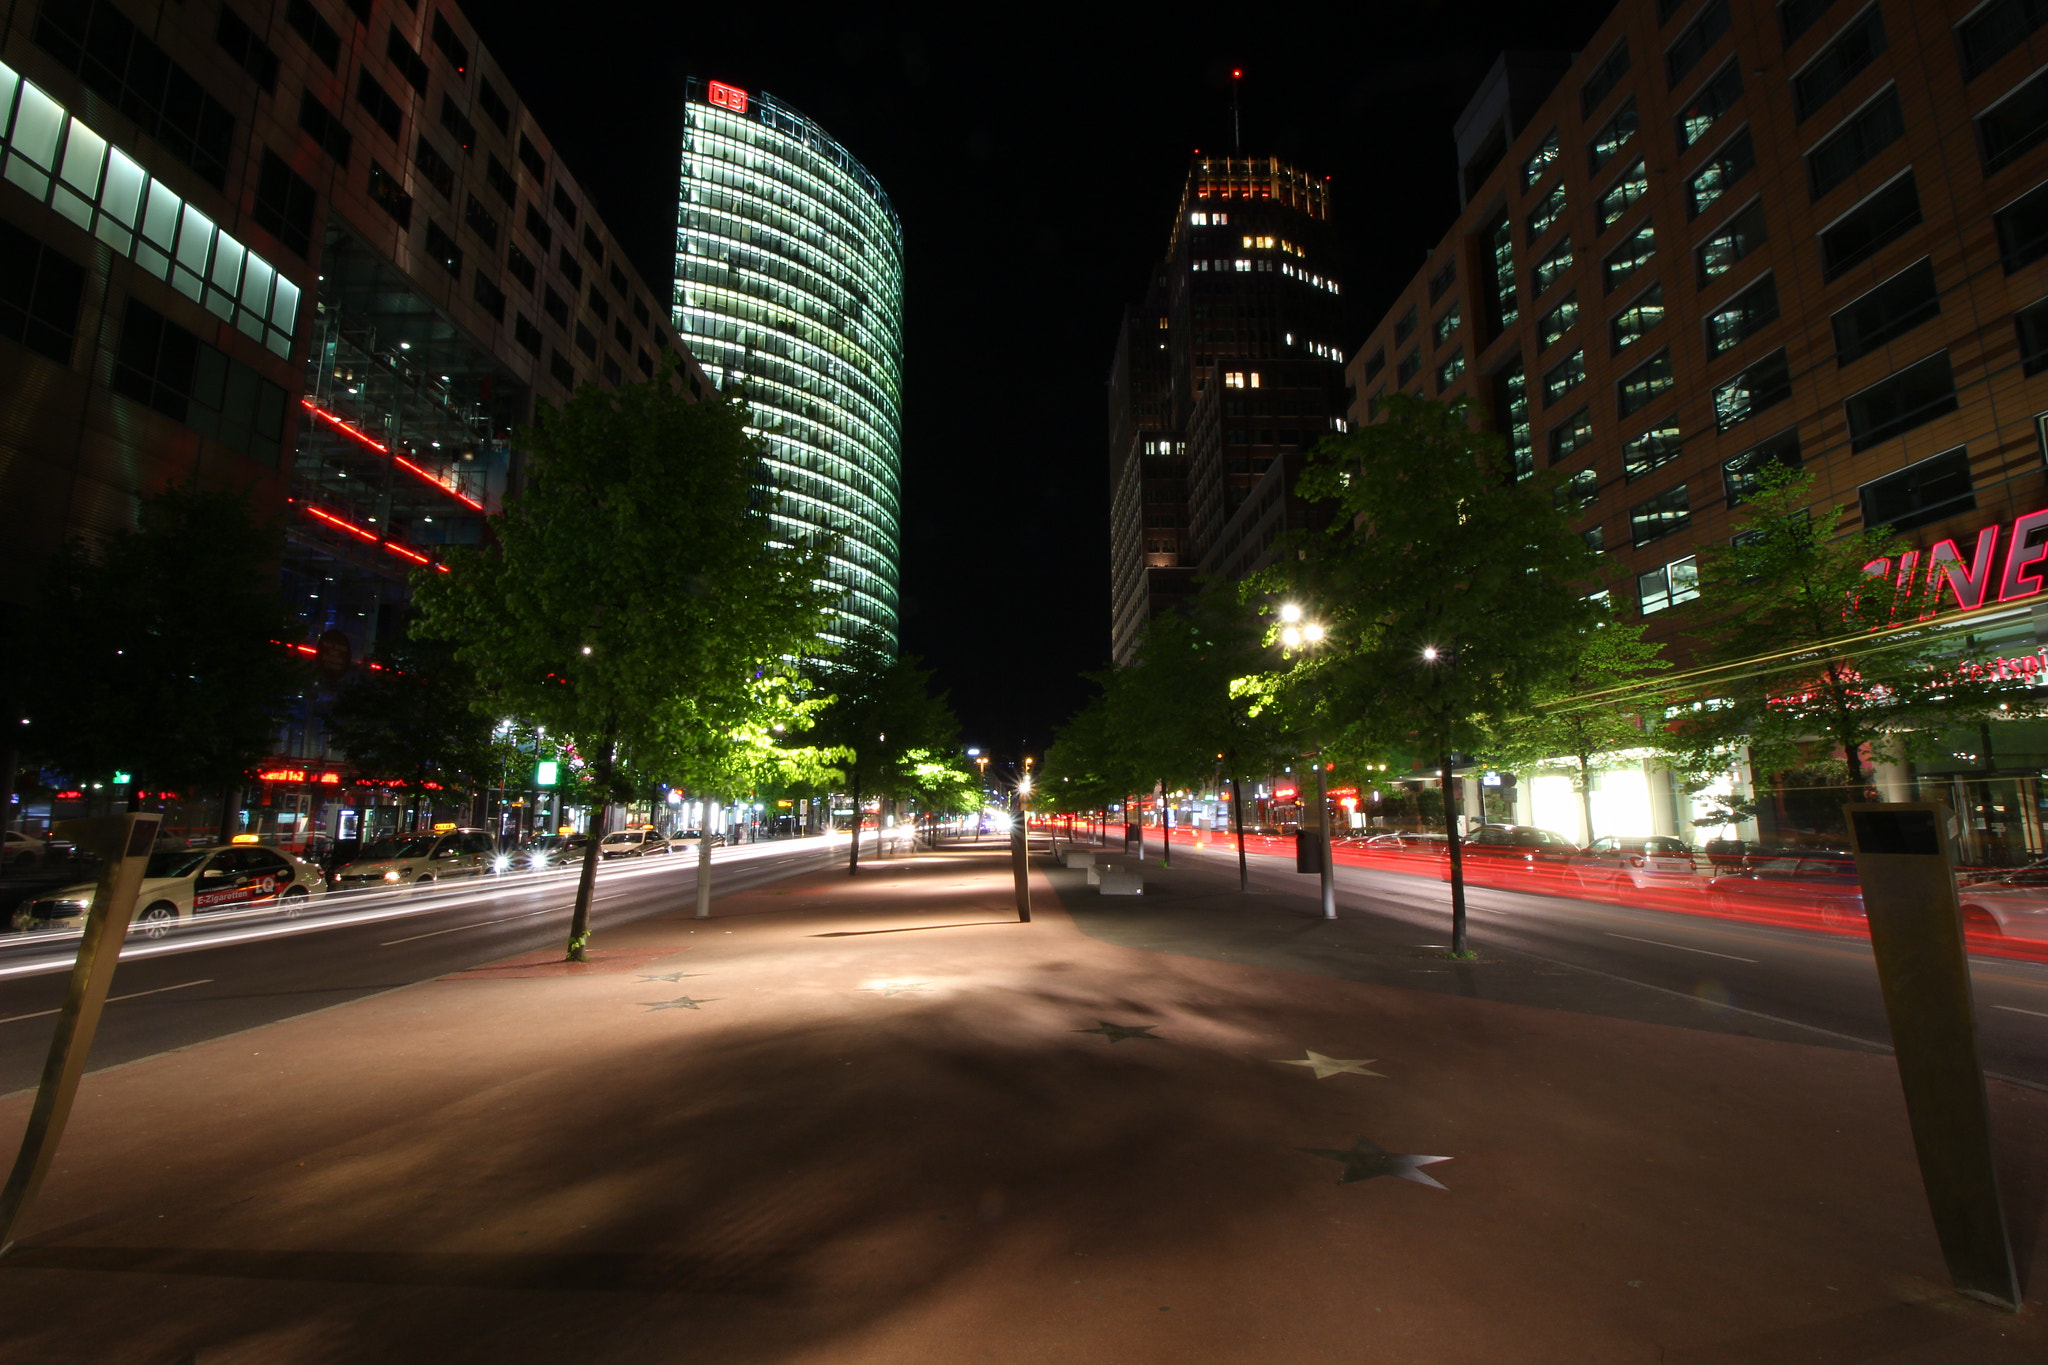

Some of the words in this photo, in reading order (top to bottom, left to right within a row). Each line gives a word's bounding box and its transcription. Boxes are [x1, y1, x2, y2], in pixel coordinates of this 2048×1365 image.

[712, 85, 743, 109] DB
[255, 877, 275, 894] LQ
[197, 890, 248, 905] E-Zigaretten
